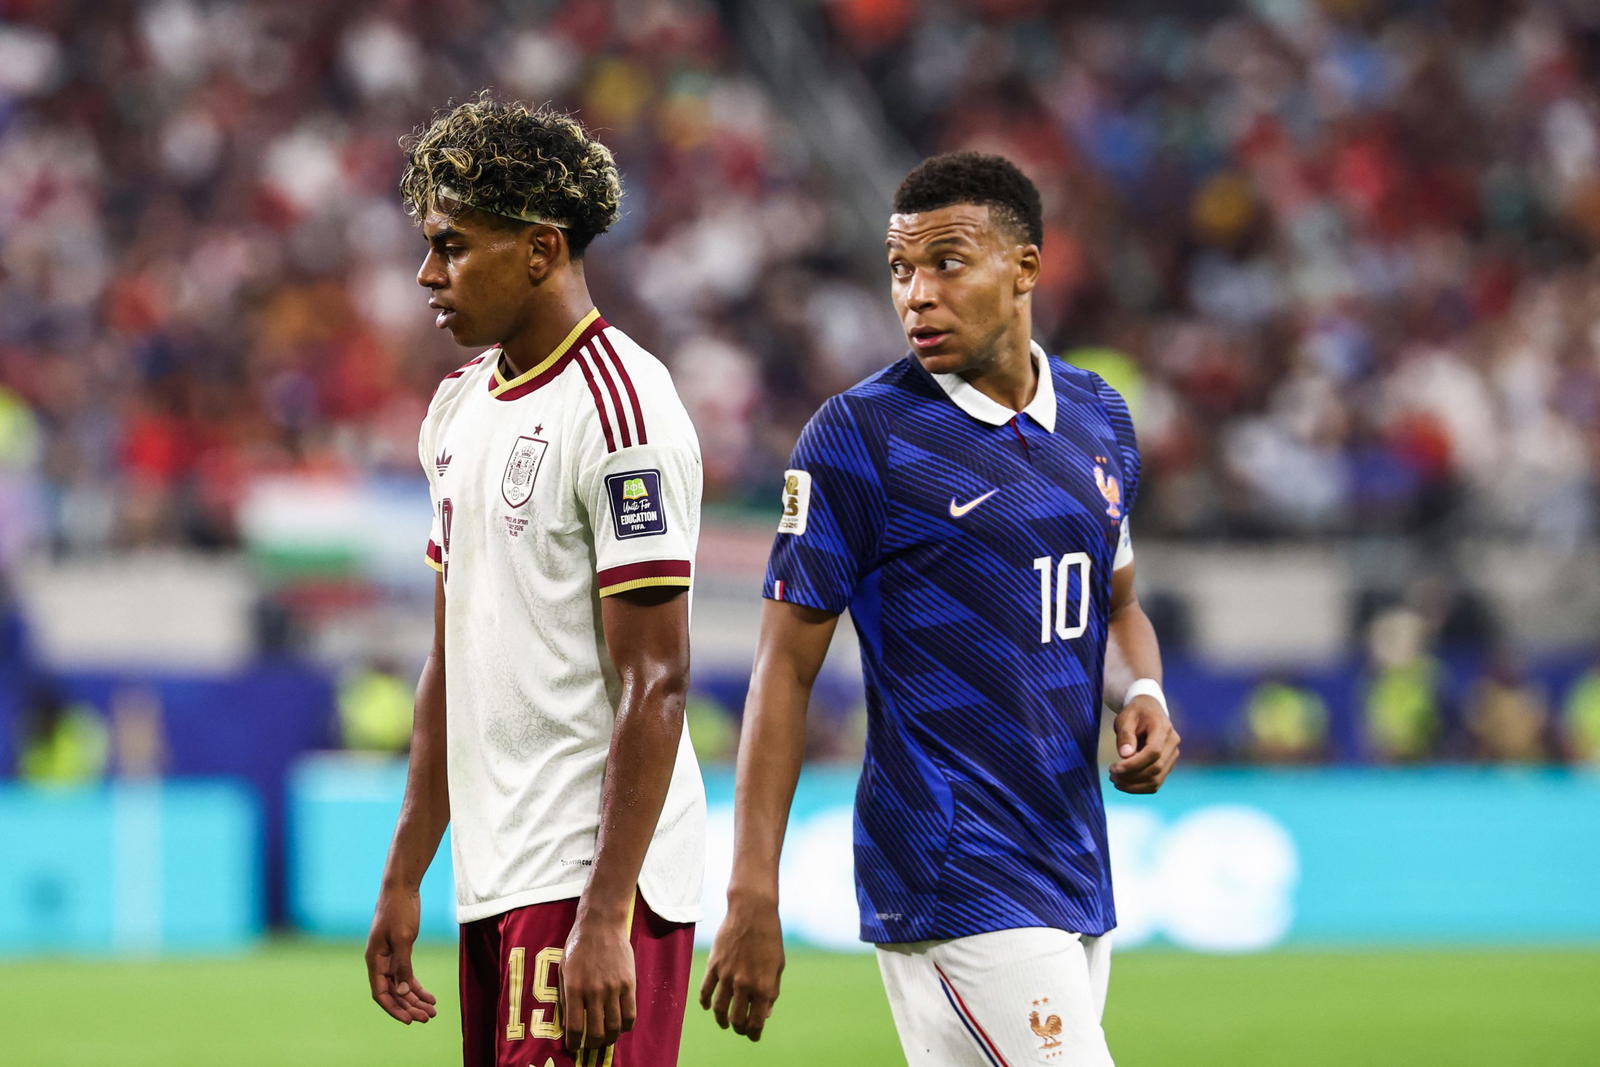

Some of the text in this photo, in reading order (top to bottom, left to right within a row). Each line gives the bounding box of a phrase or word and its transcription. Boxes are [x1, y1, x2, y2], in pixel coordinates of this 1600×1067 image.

[621, 511, 658, 525] EDUCATION
[623, 499, 652, 513] Unite For
[1033, 551, 1091, 643] 10
[506, 947, 563, 1041] 19
